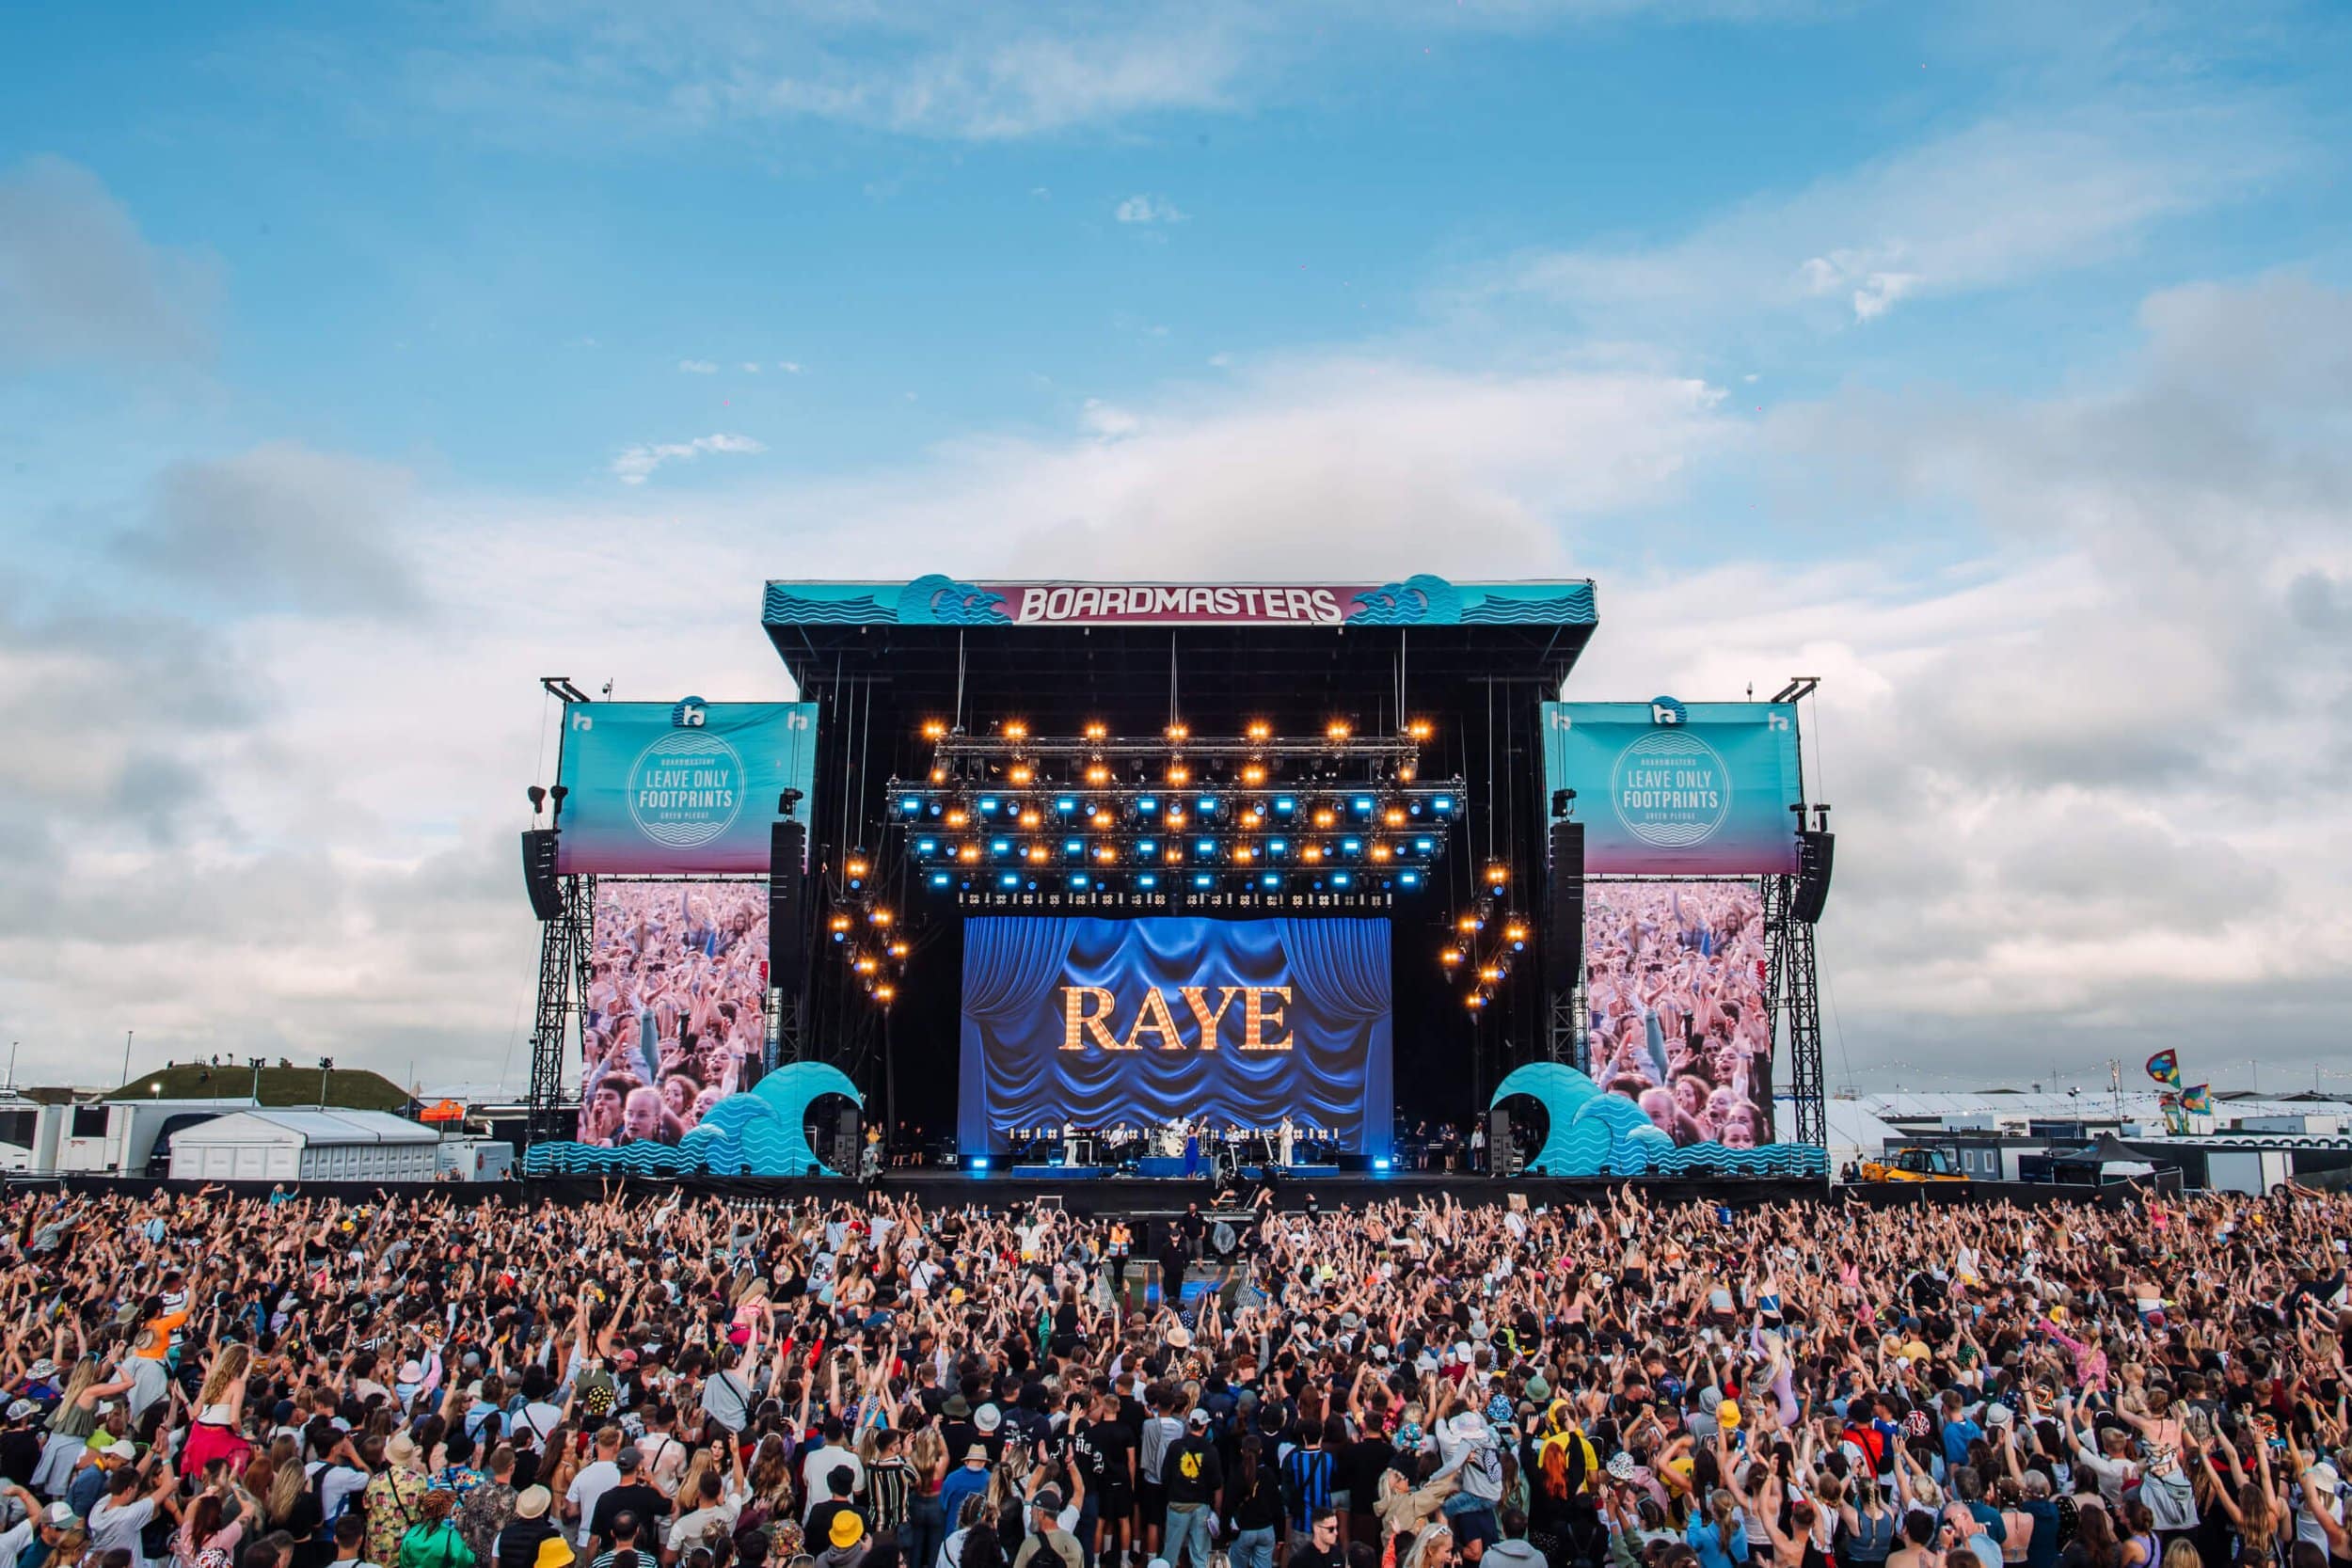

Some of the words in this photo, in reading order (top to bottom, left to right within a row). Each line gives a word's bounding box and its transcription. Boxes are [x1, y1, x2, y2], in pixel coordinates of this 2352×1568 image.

[1018, 587, 1343, 624] BOARDMASTERS
[646, 769, 689, 788] LEAVE
[693, 769, 729, 788] ONLY
[1628, 770, 1672, 788] LEAVE
[1677, 770, 1712, 788] ONLY
[640, 790, 733, 808] FOOTPRINTS
[1623, 791, 1718, 808] FOOTPRINTS
[1057, 986, 1294, 1051] RAYE
